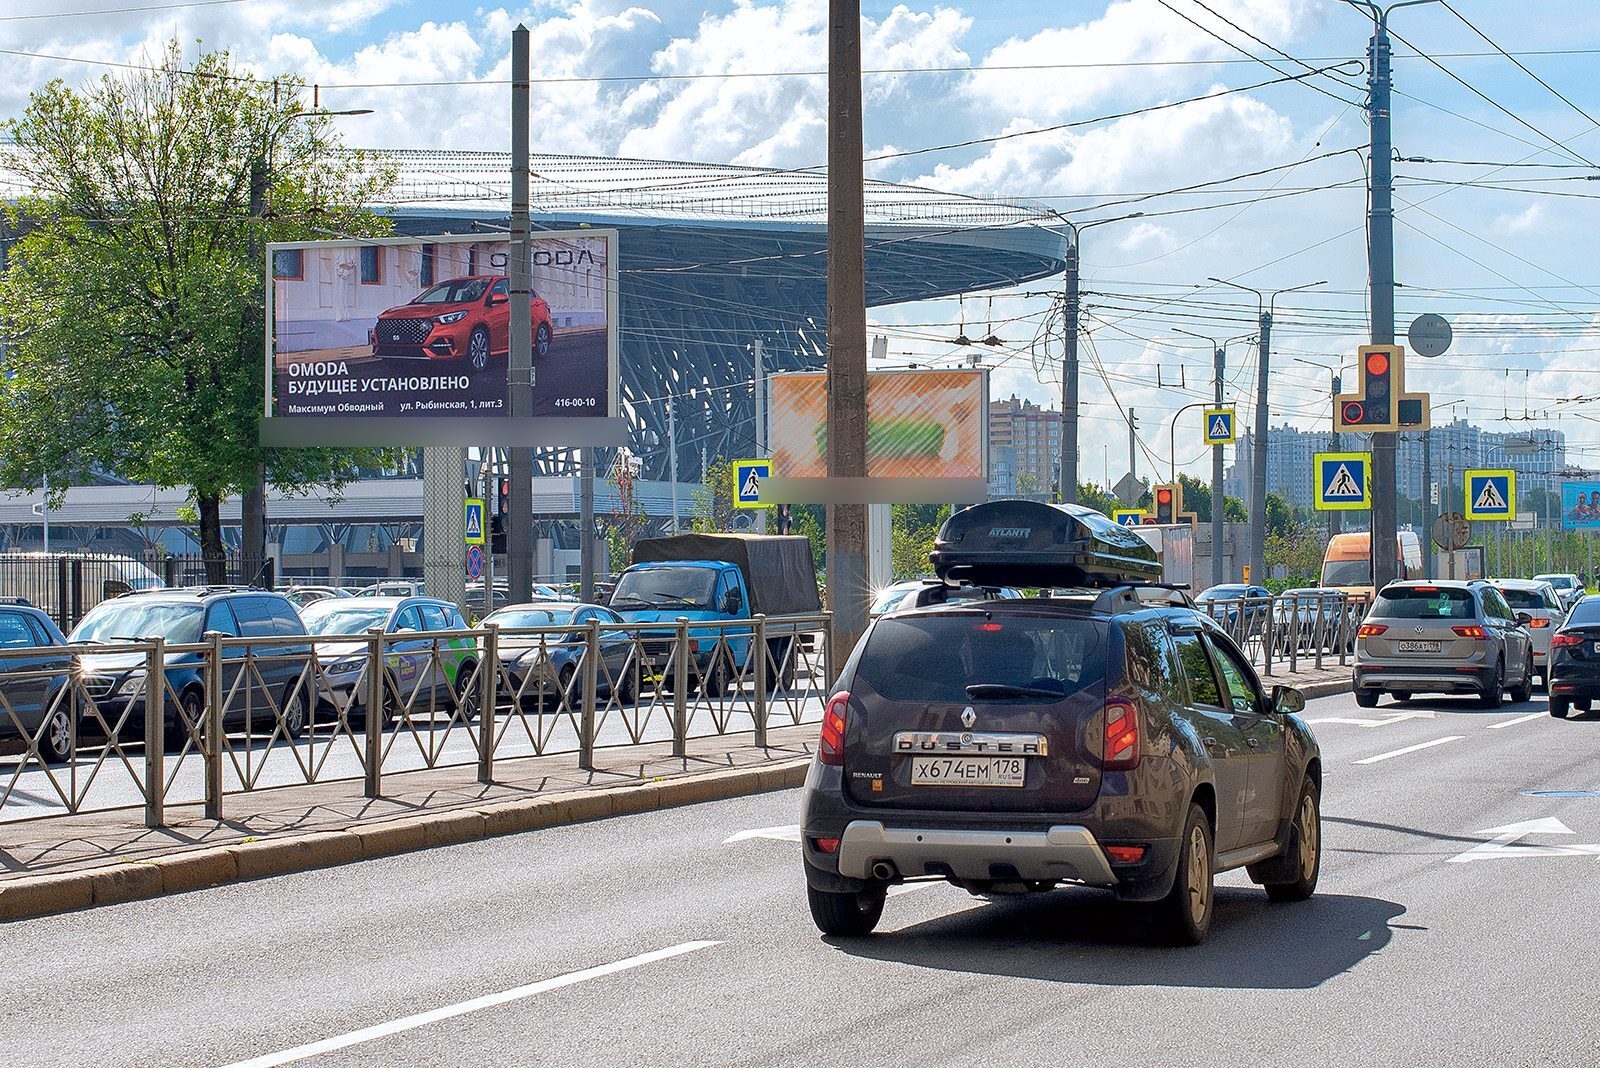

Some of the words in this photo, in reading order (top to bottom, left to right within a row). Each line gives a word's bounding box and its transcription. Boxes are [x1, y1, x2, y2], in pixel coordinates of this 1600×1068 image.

[490, 250, 594, 267] OODA
[288, 361, 349, 377] OMODA
[288, 379, 358, 395] БУДУЩЕЕ
[361, 376, 470, 392] УСТАНОВЛЕНО
[288, 404, 336, 415] Максимум
[337, 401, 384, 413] Обводный
[400, 402, 414, 412] ул.
[415, 400, 468, 411] Рыбинская,
[470, 400, 478, 409] 1,
[479, 399, 503, 409] лит.3
[554, 397, 596, 407] 416-00-10
[898, 741, 1038, 752] DUSTER
[992, 759, 1020, 774] 178
